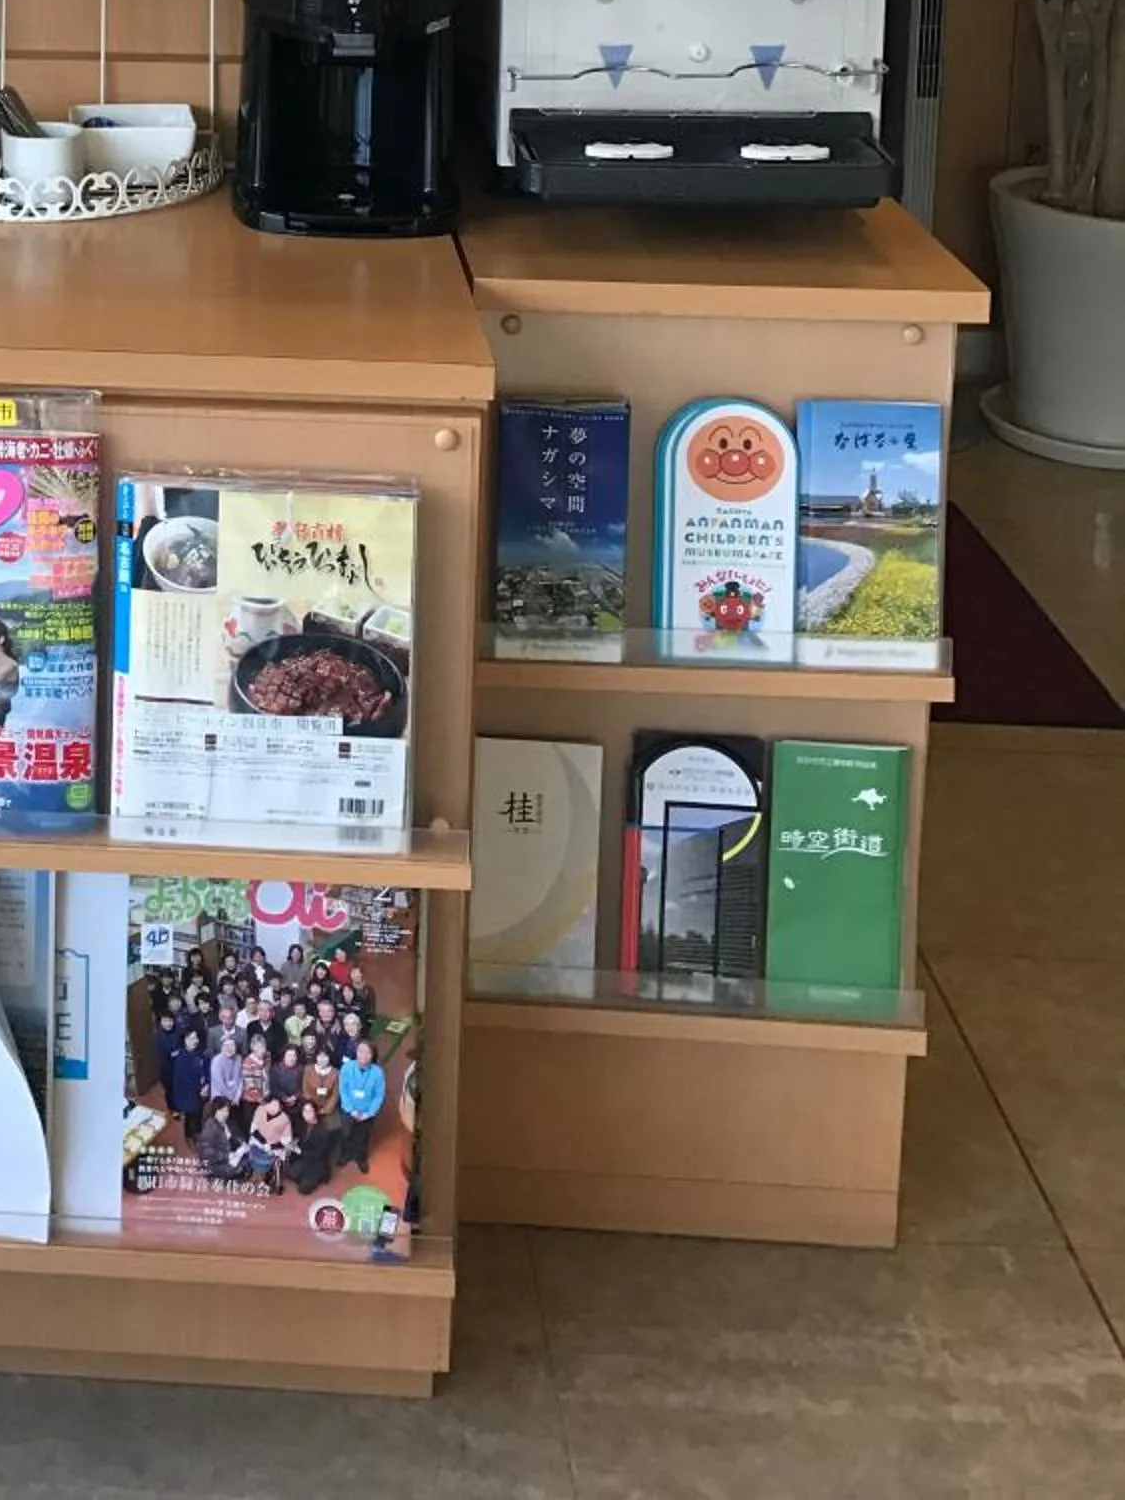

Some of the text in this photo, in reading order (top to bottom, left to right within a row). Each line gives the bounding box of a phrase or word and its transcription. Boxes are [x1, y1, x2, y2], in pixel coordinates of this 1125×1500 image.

[539, 425, 560, 511] ナガシマ
[567, 426, 589, 514] 夢の空間
[779, 826, 885, 854] 時空街道
